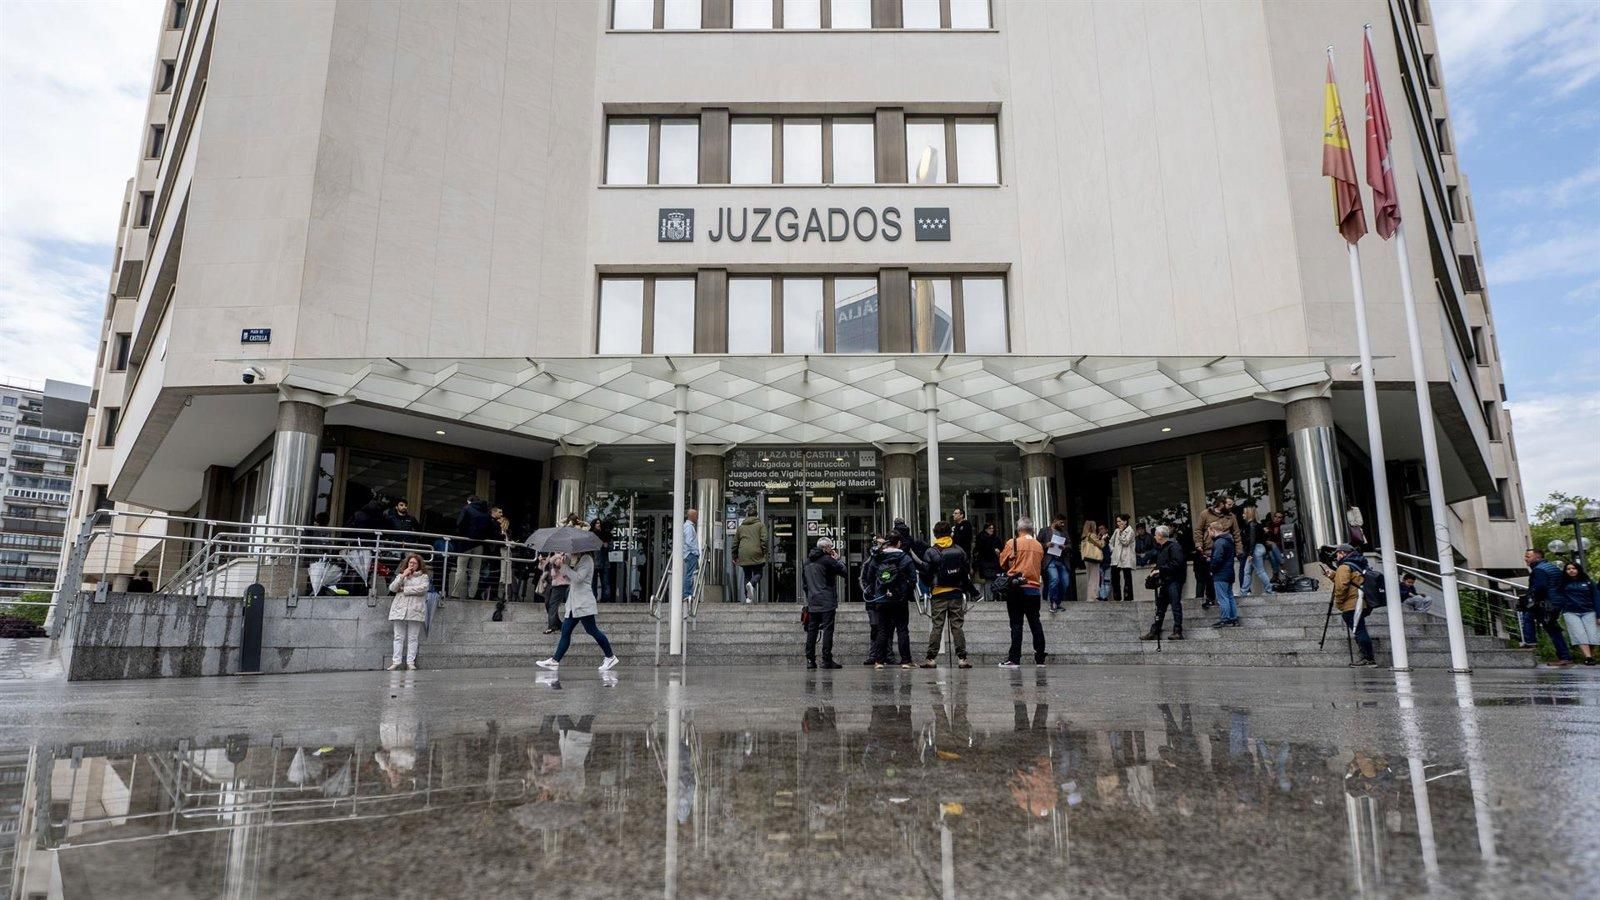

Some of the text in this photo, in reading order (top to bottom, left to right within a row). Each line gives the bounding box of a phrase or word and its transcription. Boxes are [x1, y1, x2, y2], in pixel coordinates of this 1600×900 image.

[708, 206, 902, 243] JUZGADOS
[758, 451, 787, 459] PLAZA
[790, 451, 800, 459] DE
[806, 450, 850, 459] CASTILLA
[752, 461, 791, 469] Juzgados
[728, 470, 876, 479] Juzgados de Vigilancia Penitenciaria
[794, 480, 835, 489] Juzgados
[836, 479, 846, 487] de
[848, 479, 876, 487] Madrid
